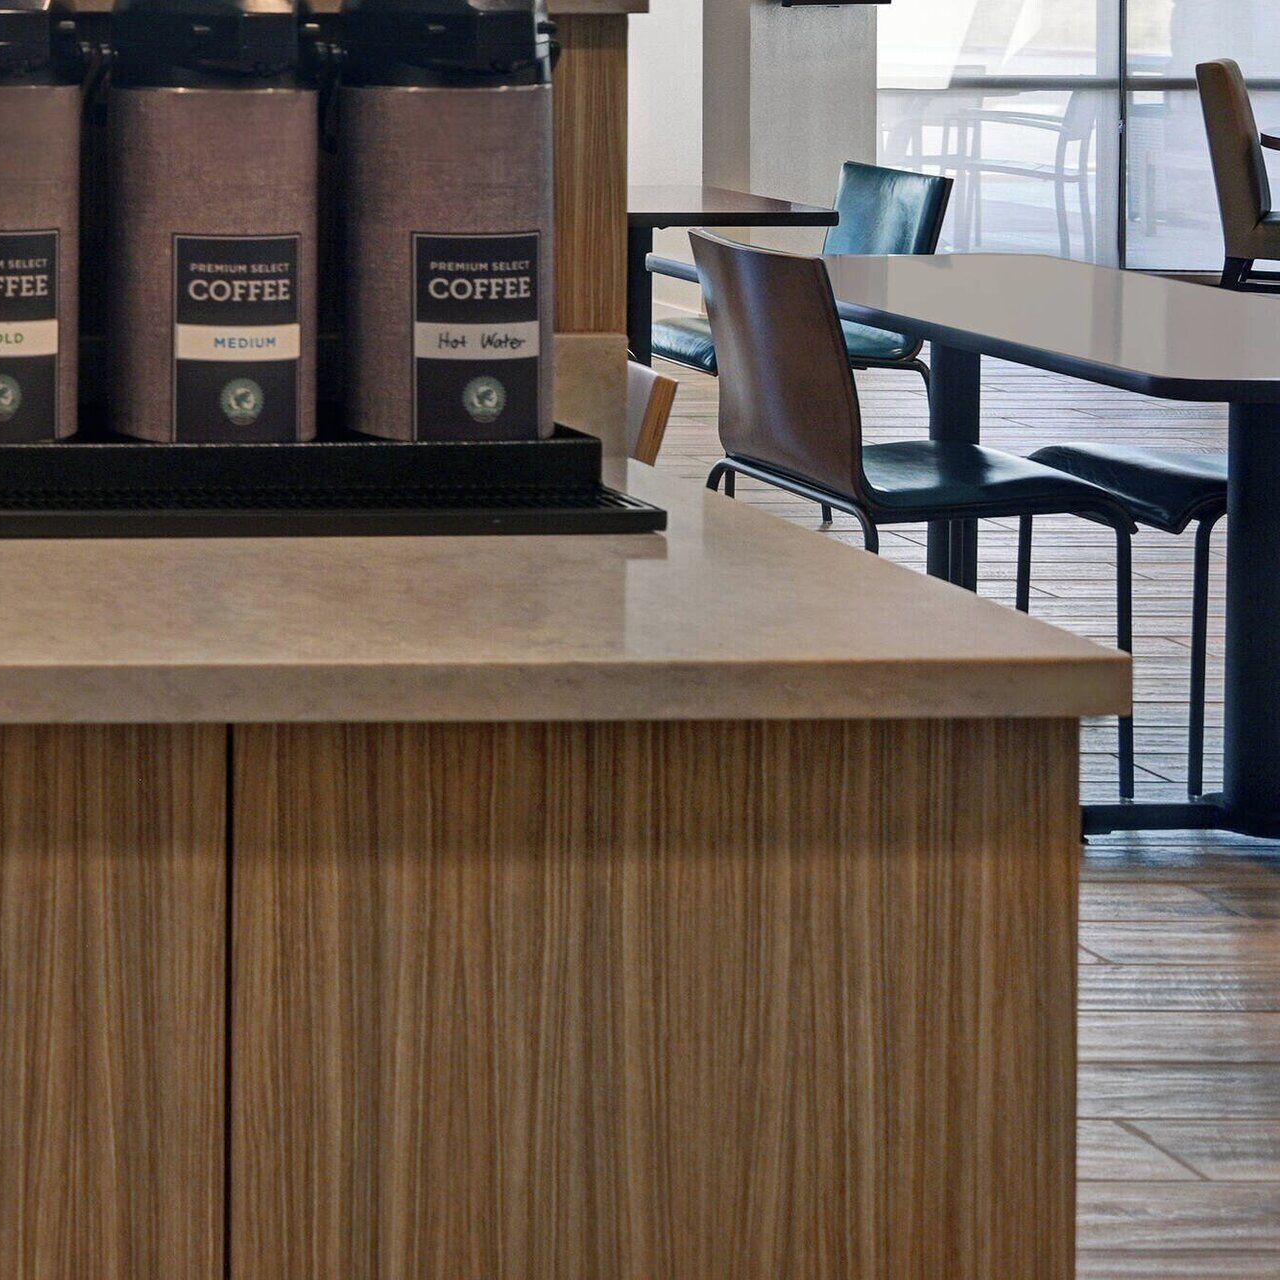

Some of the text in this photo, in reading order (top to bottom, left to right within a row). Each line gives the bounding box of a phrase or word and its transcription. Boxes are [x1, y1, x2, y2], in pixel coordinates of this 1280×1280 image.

[8, 258, 48, 269] SELECT
[190, 262, 290, 274] PREMIUM SELECT
[429, 260, 530, 272] PREMIUM SELECT
[188, 279, 290, 302] COFFEE
[428, 276, 531, 300] COFFEE
[213, 337, 277, 349] MEDIUM
[437, 332, 525, 350] Hot Water
